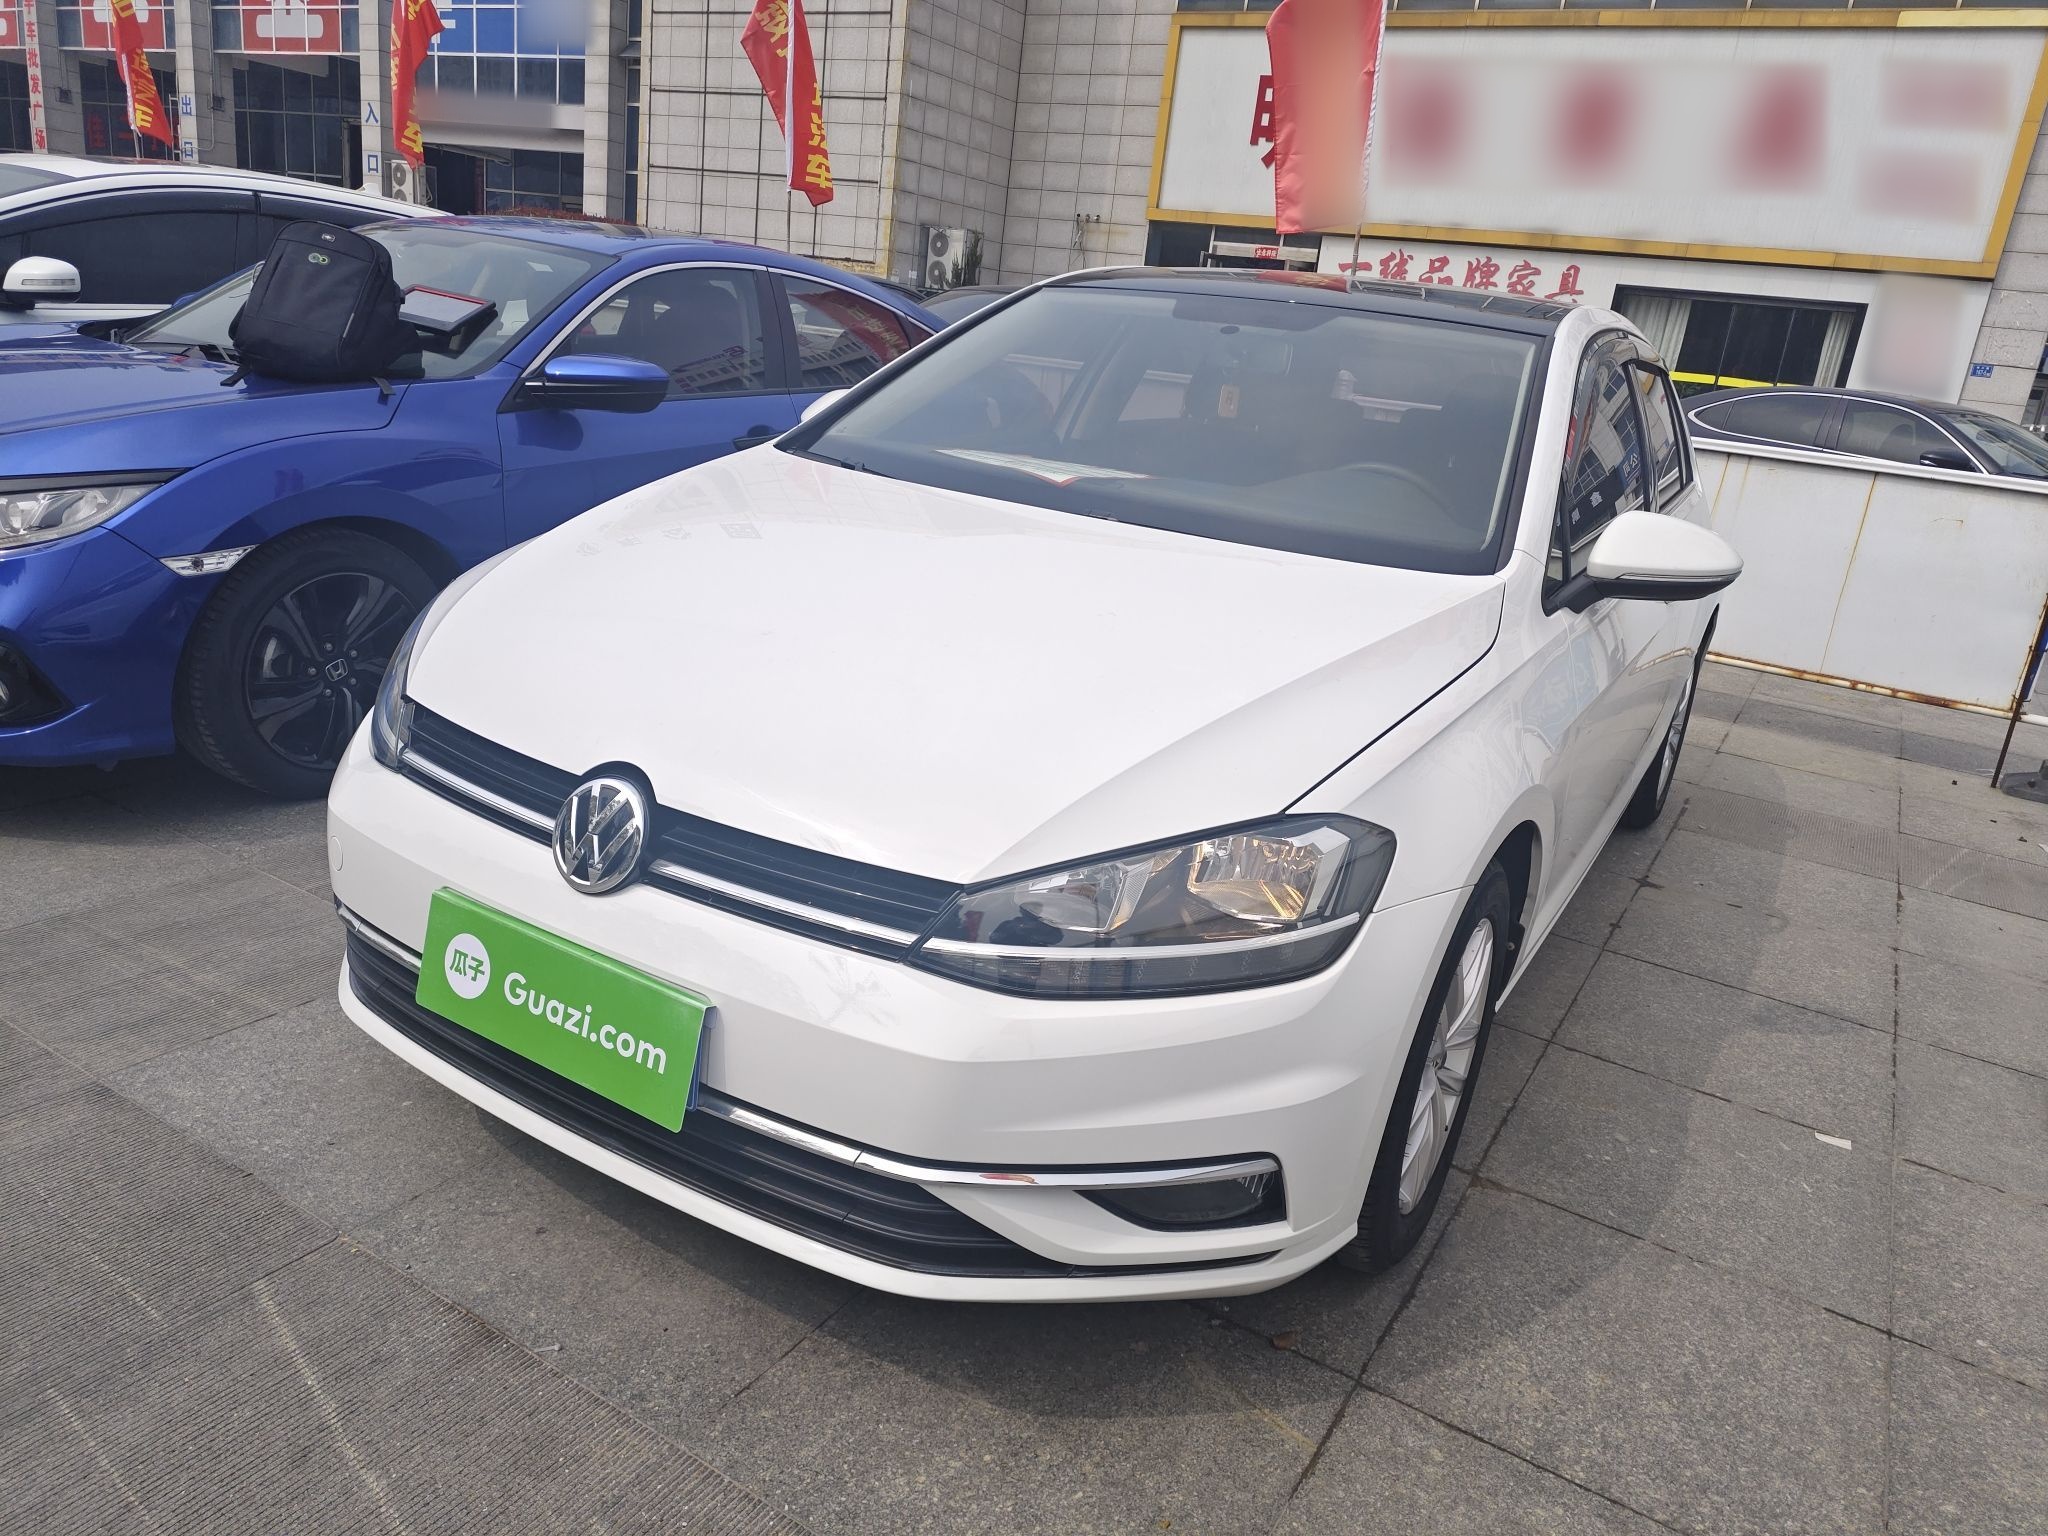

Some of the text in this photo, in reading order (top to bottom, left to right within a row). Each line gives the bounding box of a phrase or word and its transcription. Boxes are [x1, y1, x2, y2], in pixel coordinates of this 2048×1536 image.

[181, 94, 194, 159] 出口
[365, 102, 379, 174] 入口
[1338, 249, 1585, 304] 一线品牌家具
[449, 949, 485, 982] 瓜子
[503, 972, 667, 1075] Guazi.com
